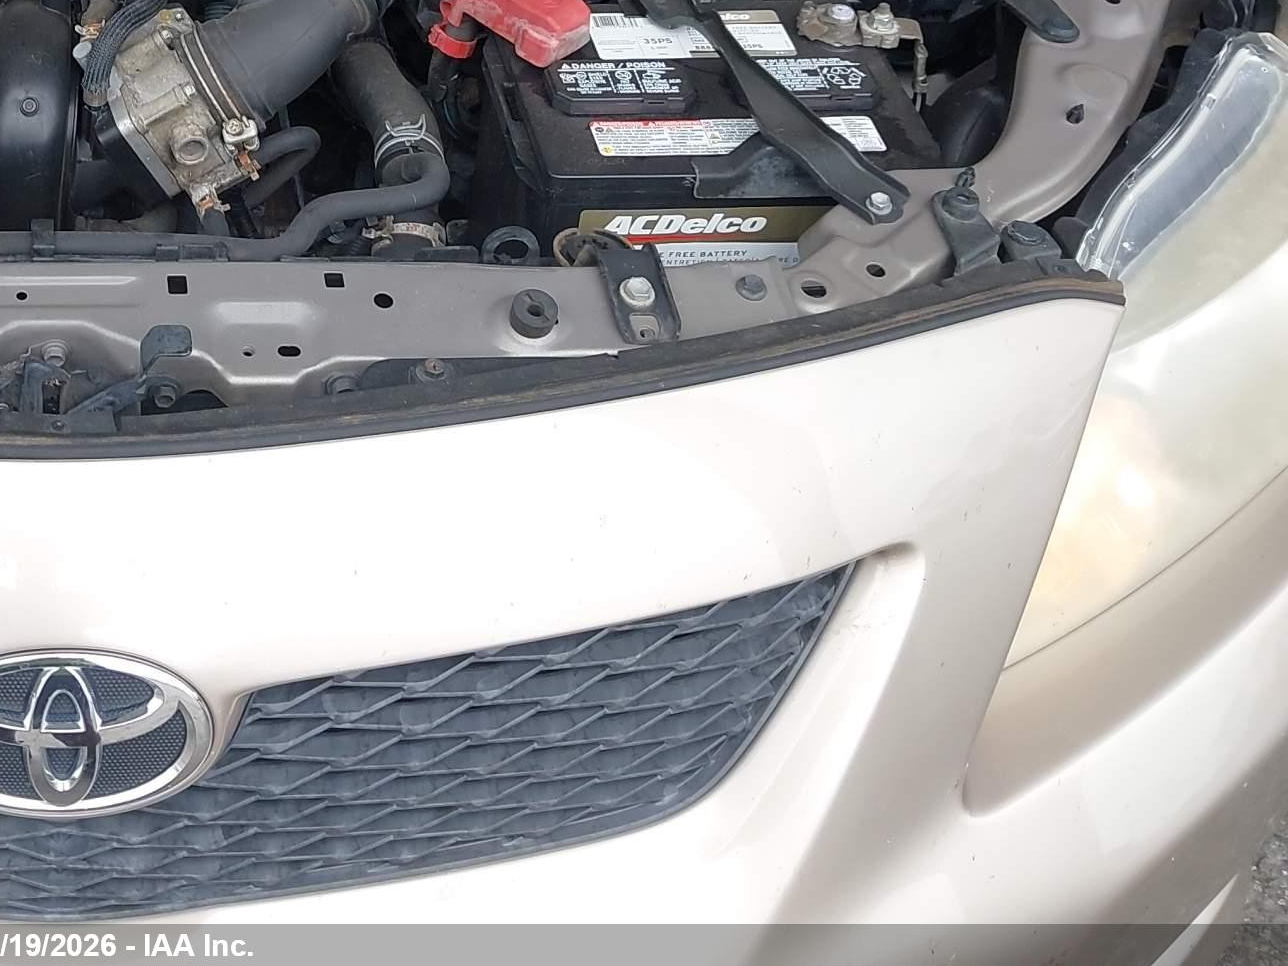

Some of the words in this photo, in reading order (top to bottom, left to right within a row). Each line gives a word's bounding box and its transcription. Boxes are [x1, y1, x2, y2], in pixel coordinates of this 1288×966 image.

[625, 61, 666, 69] POISON
[604, 213, 768, 235] ACDelco
[700, 249, 748, 257] BATTERY
